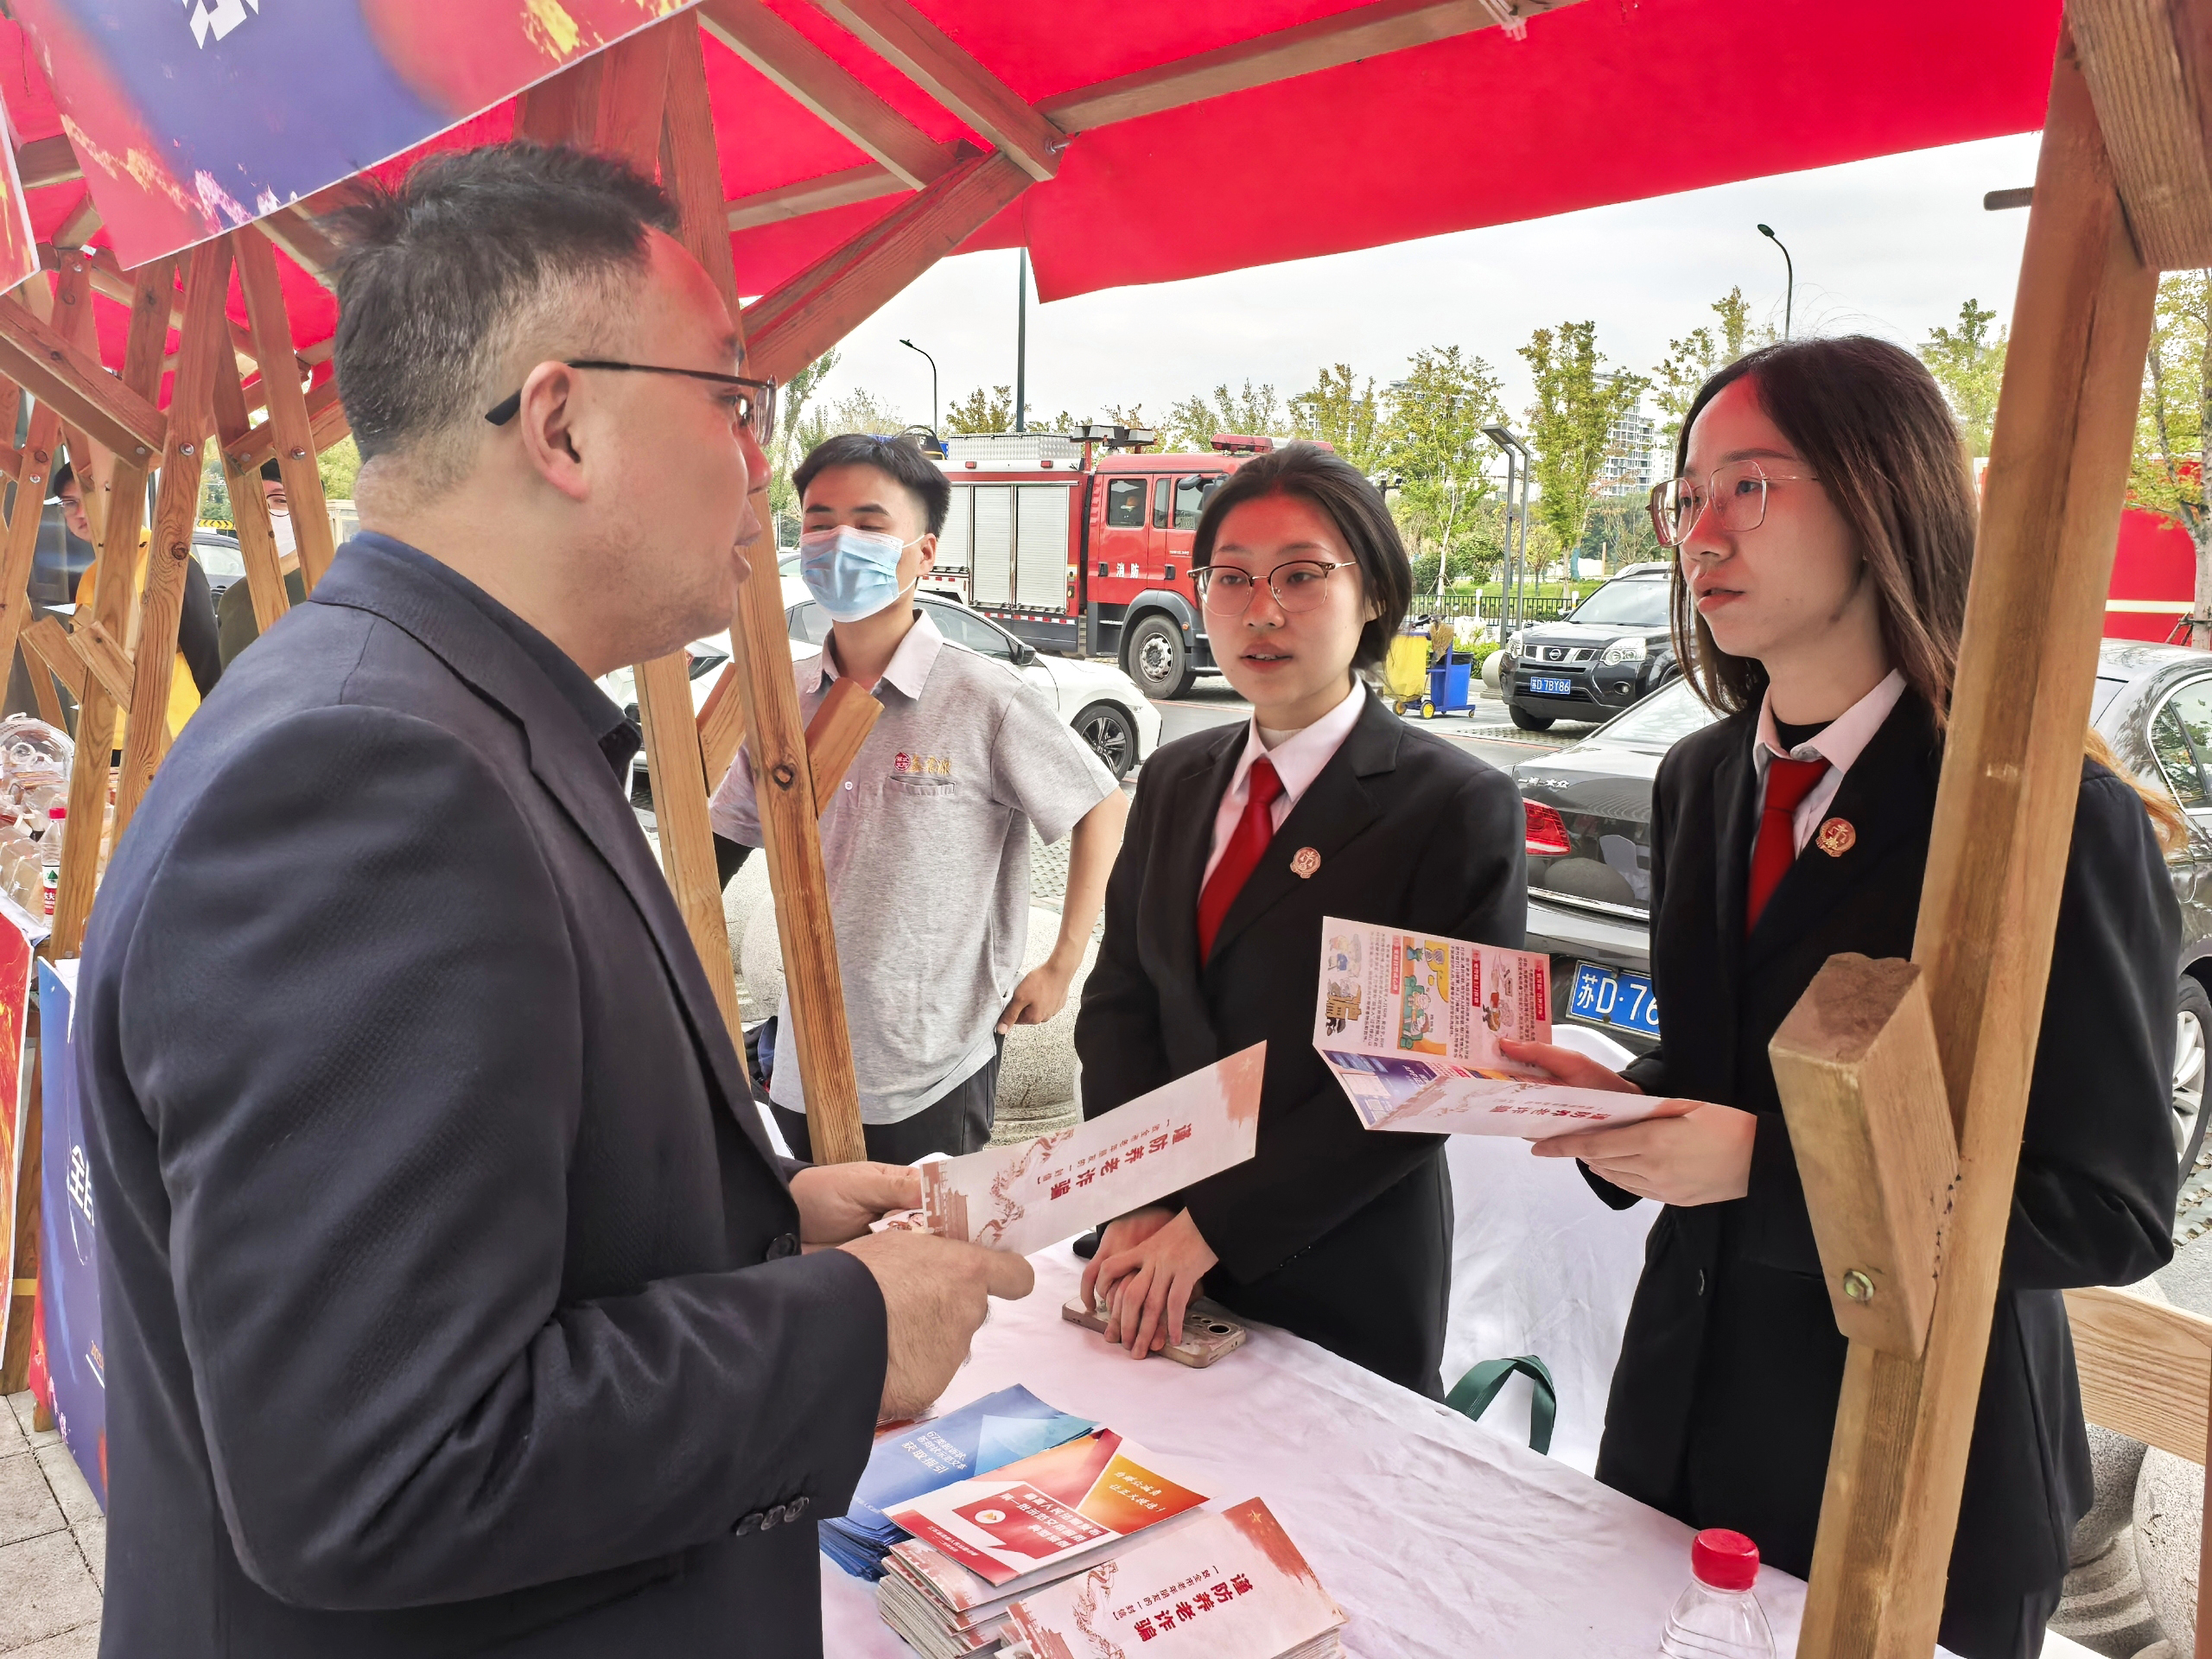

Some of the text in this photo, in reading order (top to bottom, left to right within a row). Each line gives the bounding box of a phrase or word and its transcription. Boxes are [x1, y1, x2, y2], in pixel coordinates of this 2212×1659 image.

[1116, 562, 1140, 579] 消防
[1488, 1104, 1611, 1122] 谨防养老诈骗
[1050, 1122, 1192, 1201] 谨防养老诈骗
[901, 1440, 950, 1474] 获取指引
[1022, 1491, 1103, 1537] 最高人民法院发布
[1134, 1573, 1254, 1643] 谨防养老诈骗
